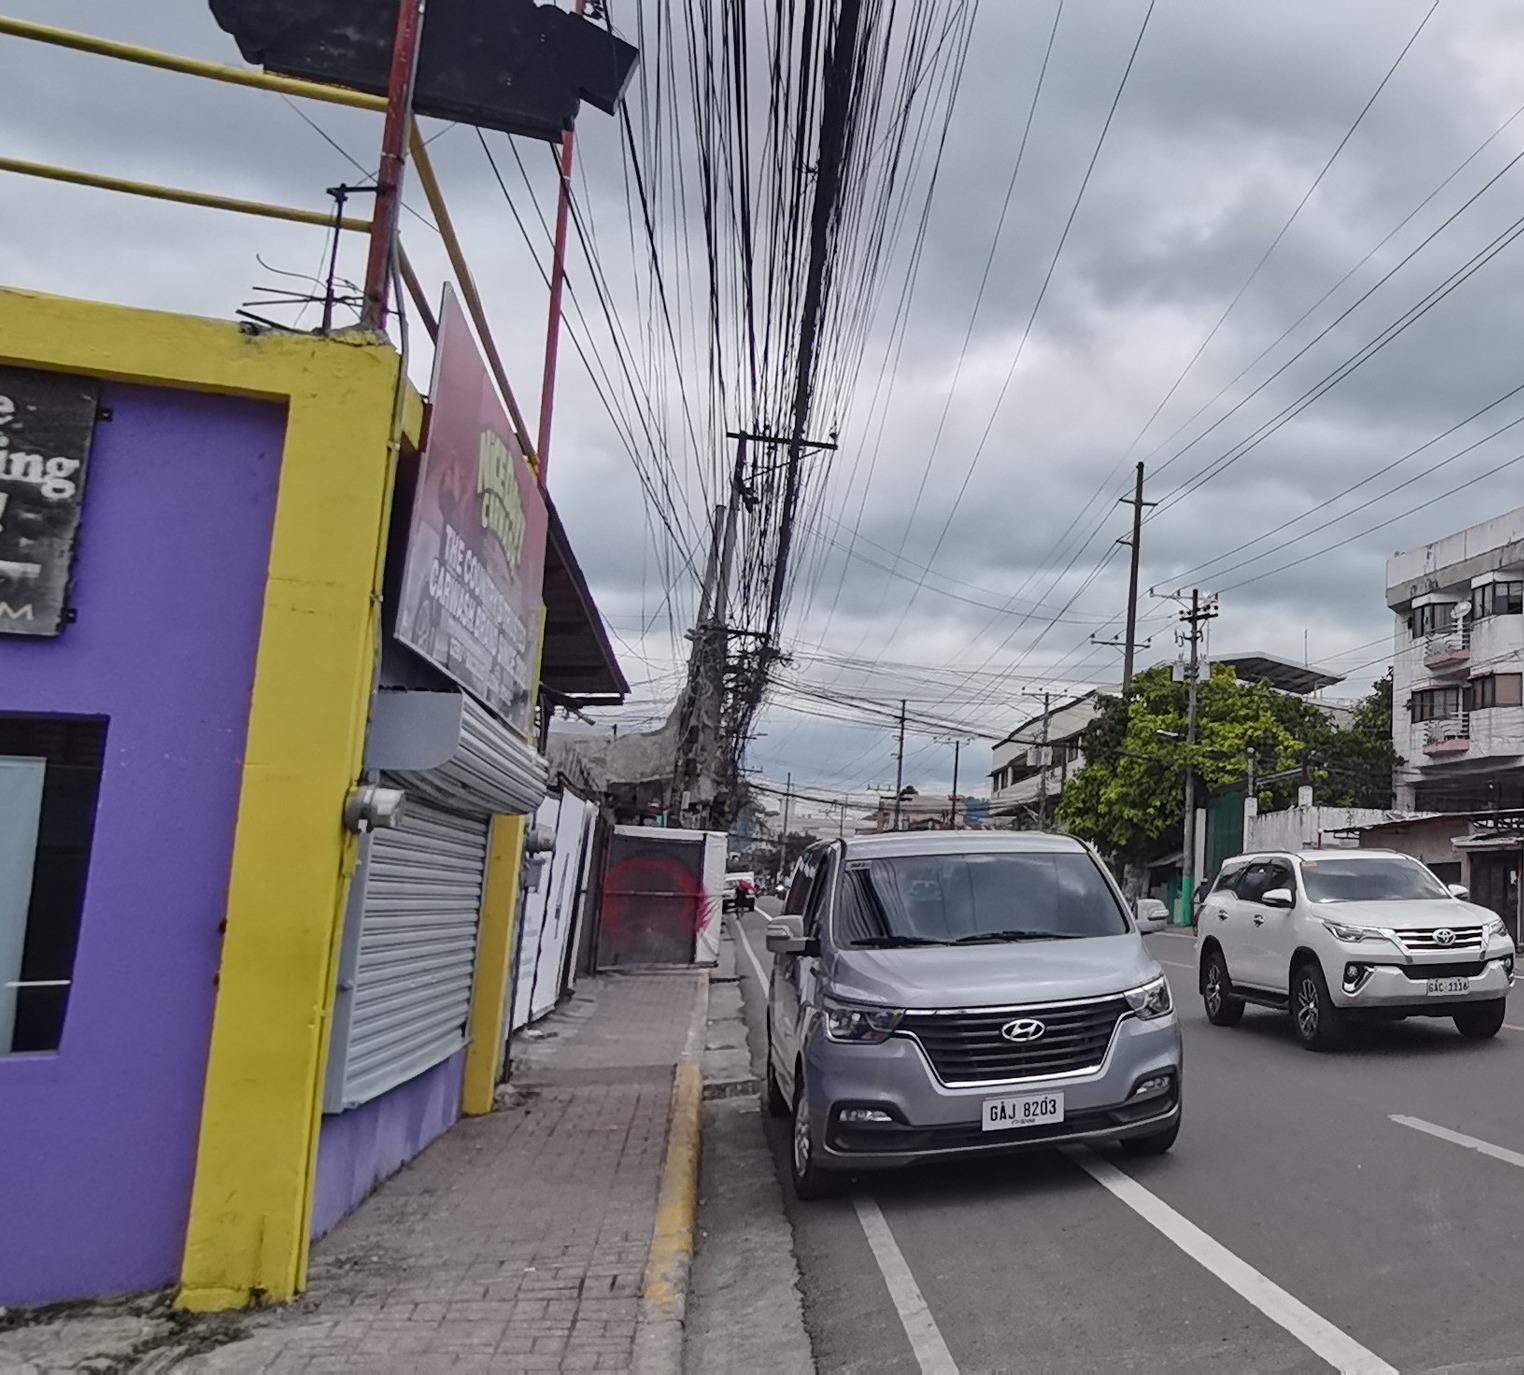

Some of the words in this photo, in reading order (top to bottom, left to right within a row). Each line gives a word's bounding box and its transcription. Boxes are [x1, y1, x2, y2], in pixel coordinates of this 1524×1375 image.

[445, 523, 465, 576] THE
[429, 558, 476, 634] CARWASH
[990, 1102, 1016, 1122] GAJ
[1023, 1099, 1057, 1118] 8203
